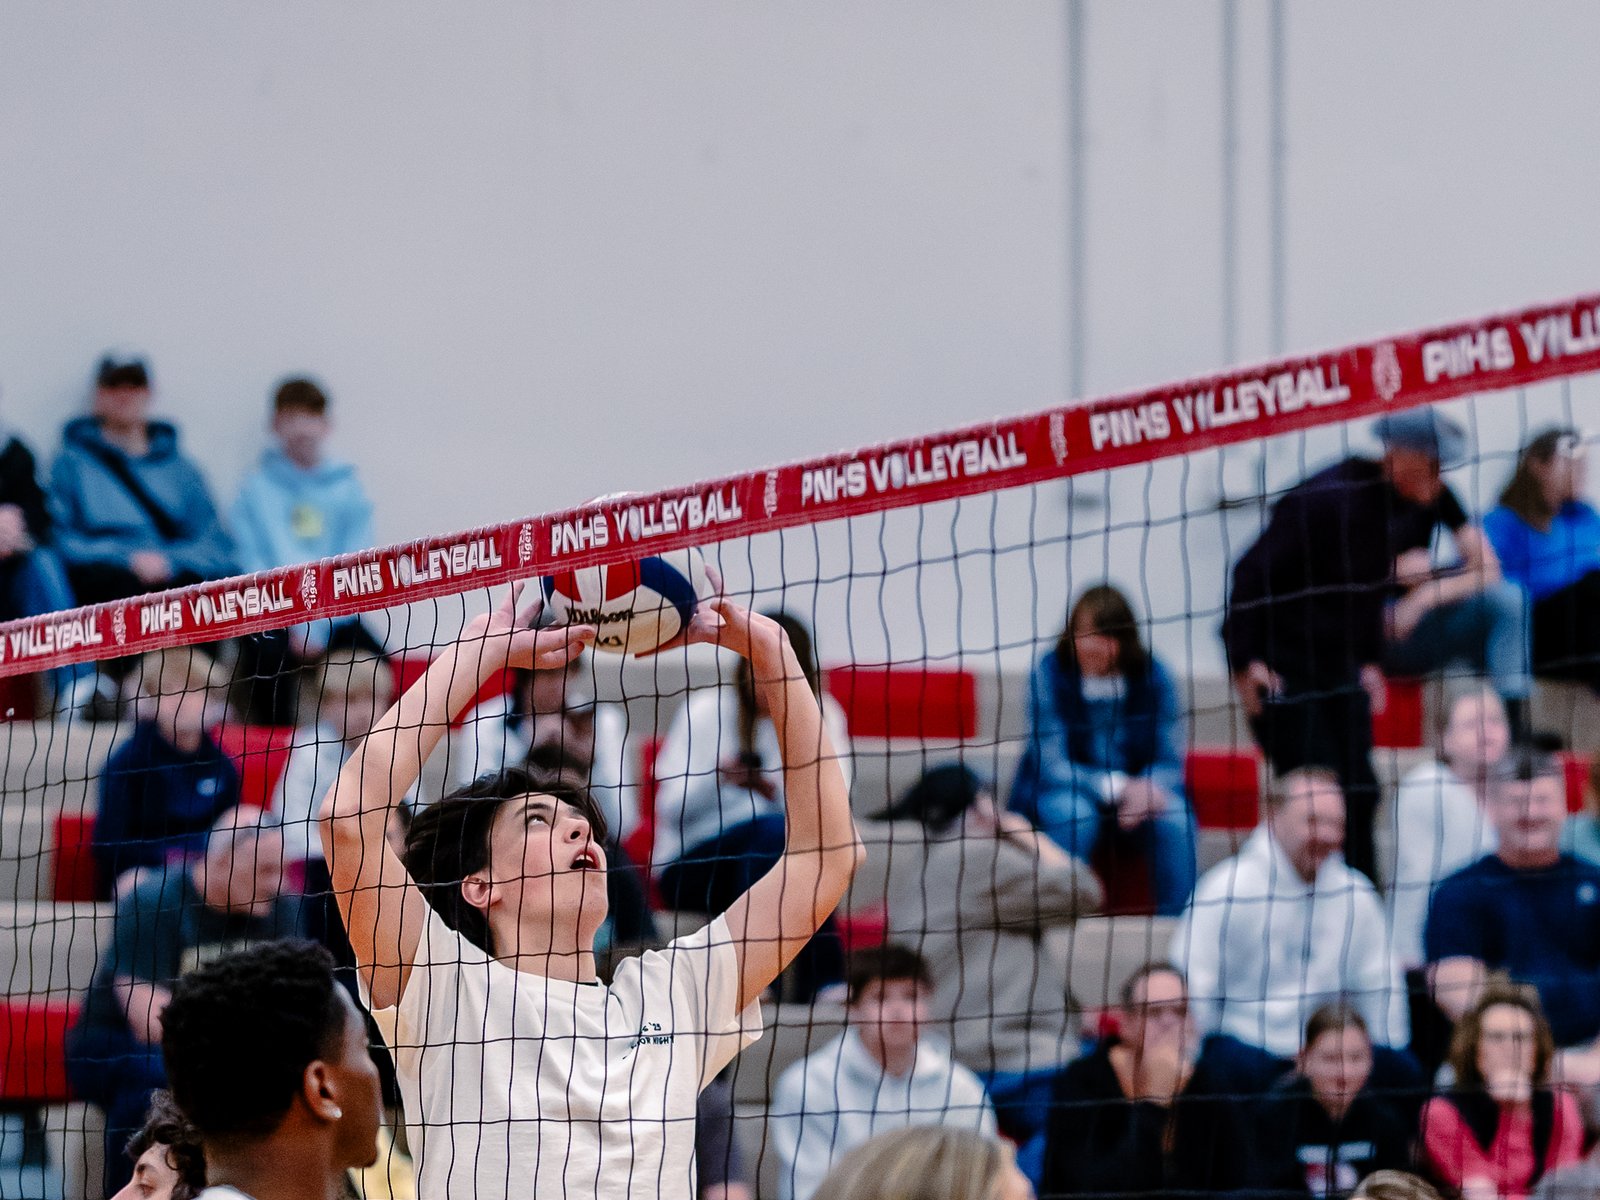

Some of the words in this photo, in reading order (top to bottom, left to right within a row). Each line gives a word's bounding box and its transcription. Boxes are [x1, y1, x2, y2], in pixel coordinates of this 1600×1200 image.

[1089, 401, 1171, 451] PNHS
[801, 461, 867, 507] PNHS
[869, 432, 1027, 492] VOLLEYBALL
[551, 514, 609, 557] PNHS
[613, 486, 742, 543] VOLLEYBALL
[333, 562, 384, 600] PNHS
[389, 537, 502, 589] VOLLEYBALL
[188, 581, 294, 627] VOLLEYBALL
